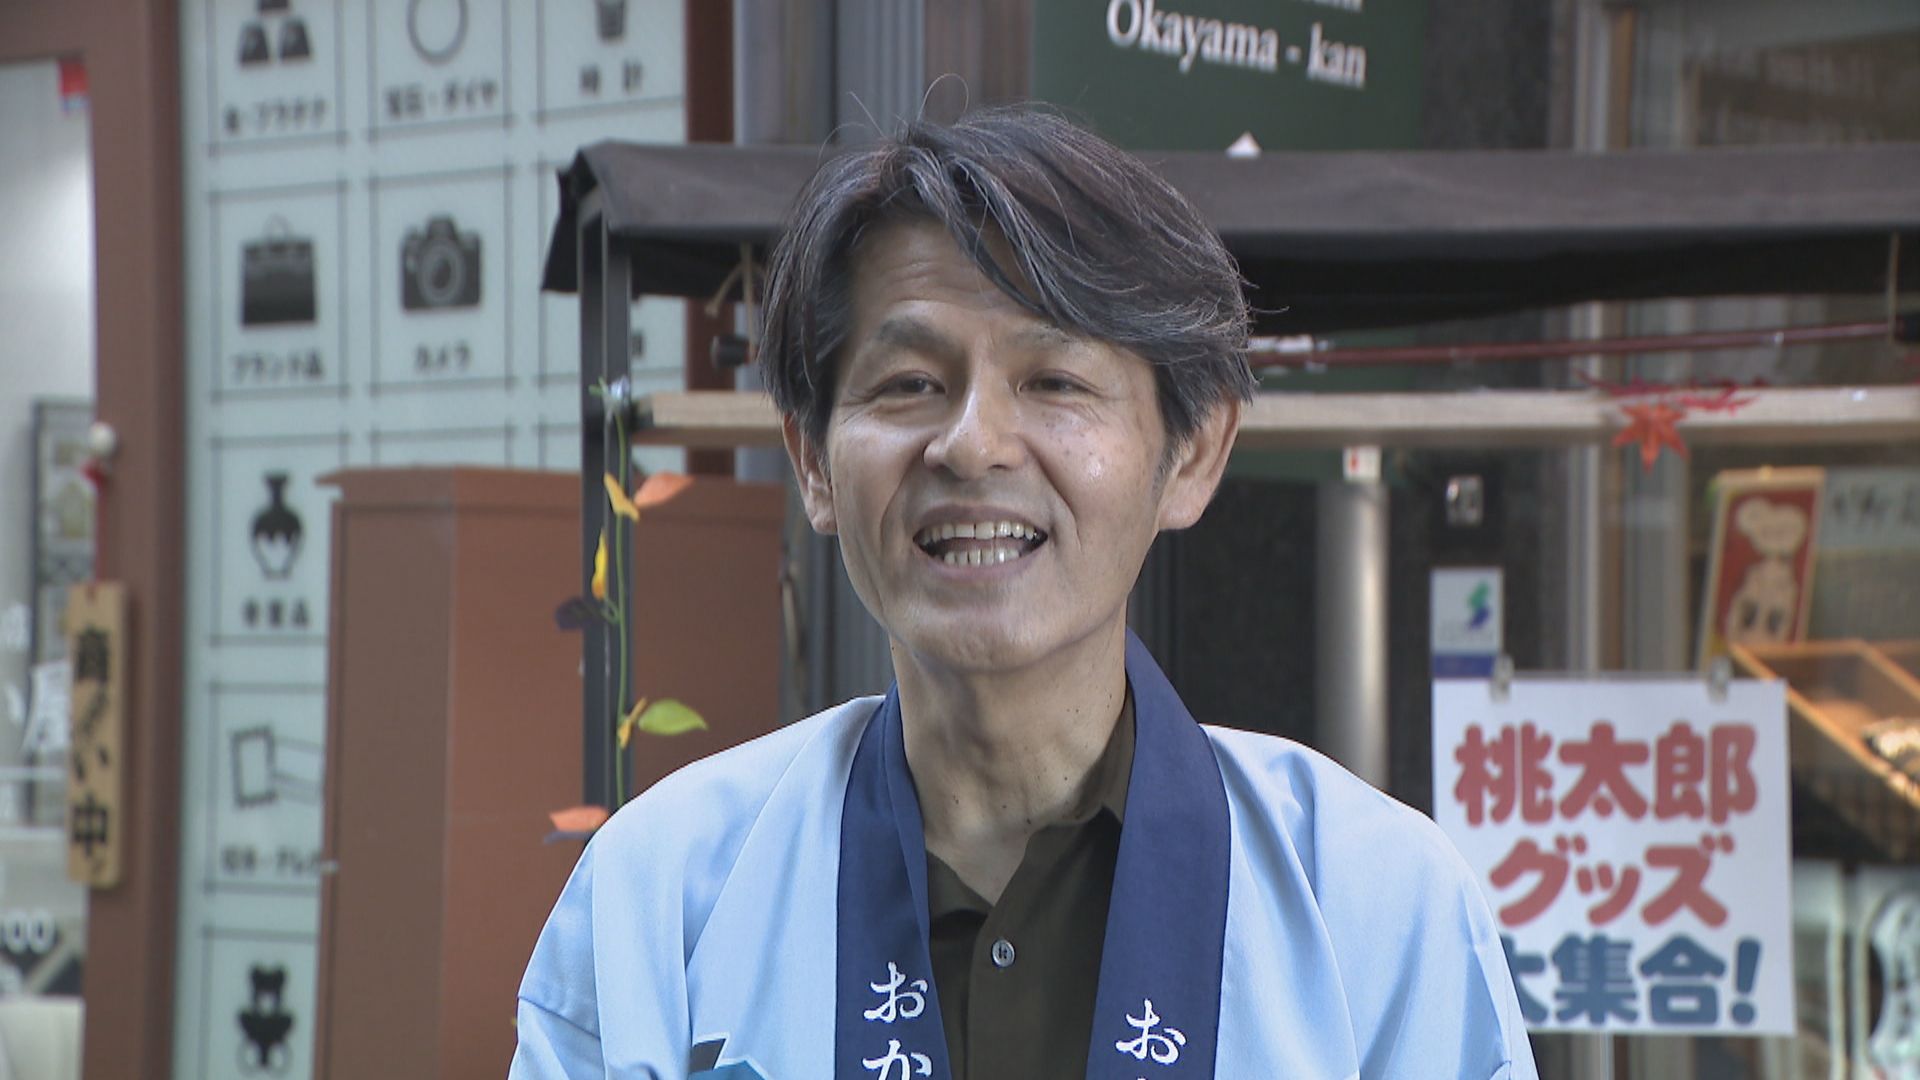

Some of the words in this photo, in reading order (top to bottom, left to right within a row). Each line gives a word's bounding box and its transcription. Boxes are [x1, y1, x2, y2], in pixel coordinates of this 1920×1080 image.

[1106, 0, 1279, 74] Okayama
[1306, 22, 1367, 90] kan
[1453, 721, 1759, 826] 桃太郎
[1489, 832, 1736, 928] グッズ
[862, 961, 933, 1080] おか
[1115, 998, 1187, 1080] お
